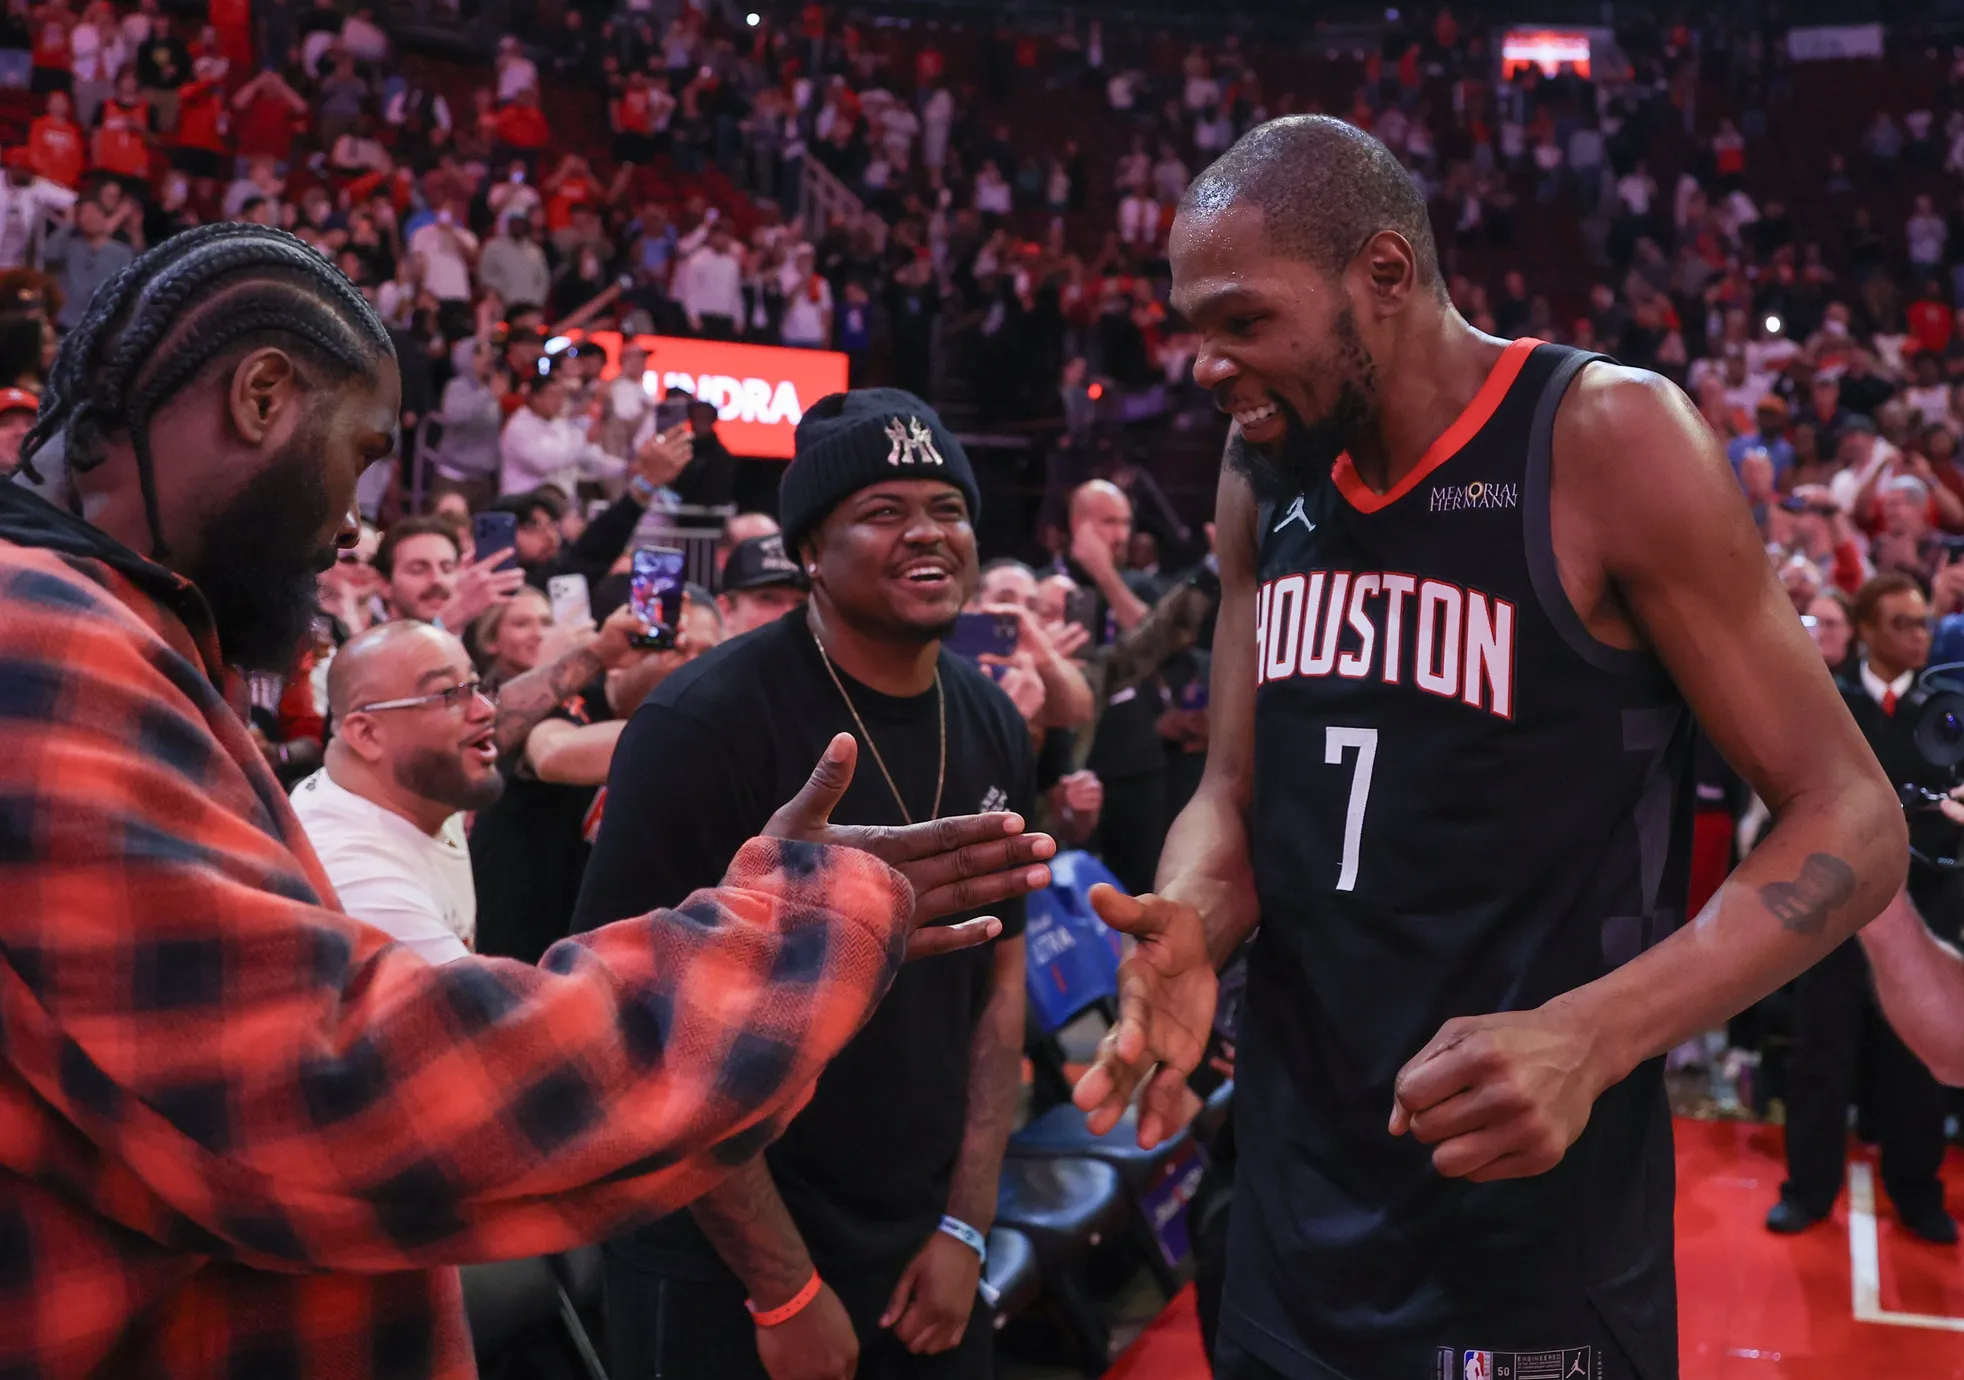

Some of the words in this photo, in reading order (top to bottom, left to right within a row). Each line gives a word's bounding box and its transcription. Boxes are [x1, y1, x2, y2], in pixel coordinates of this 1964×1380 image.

[1430, 482, 1517, 500] MEMORIAL
[1430, 494, 1518, 512] HERMANN
[1324, 726, 1378, 891] 7
[1497, 1366, 1510, 1377] 50
